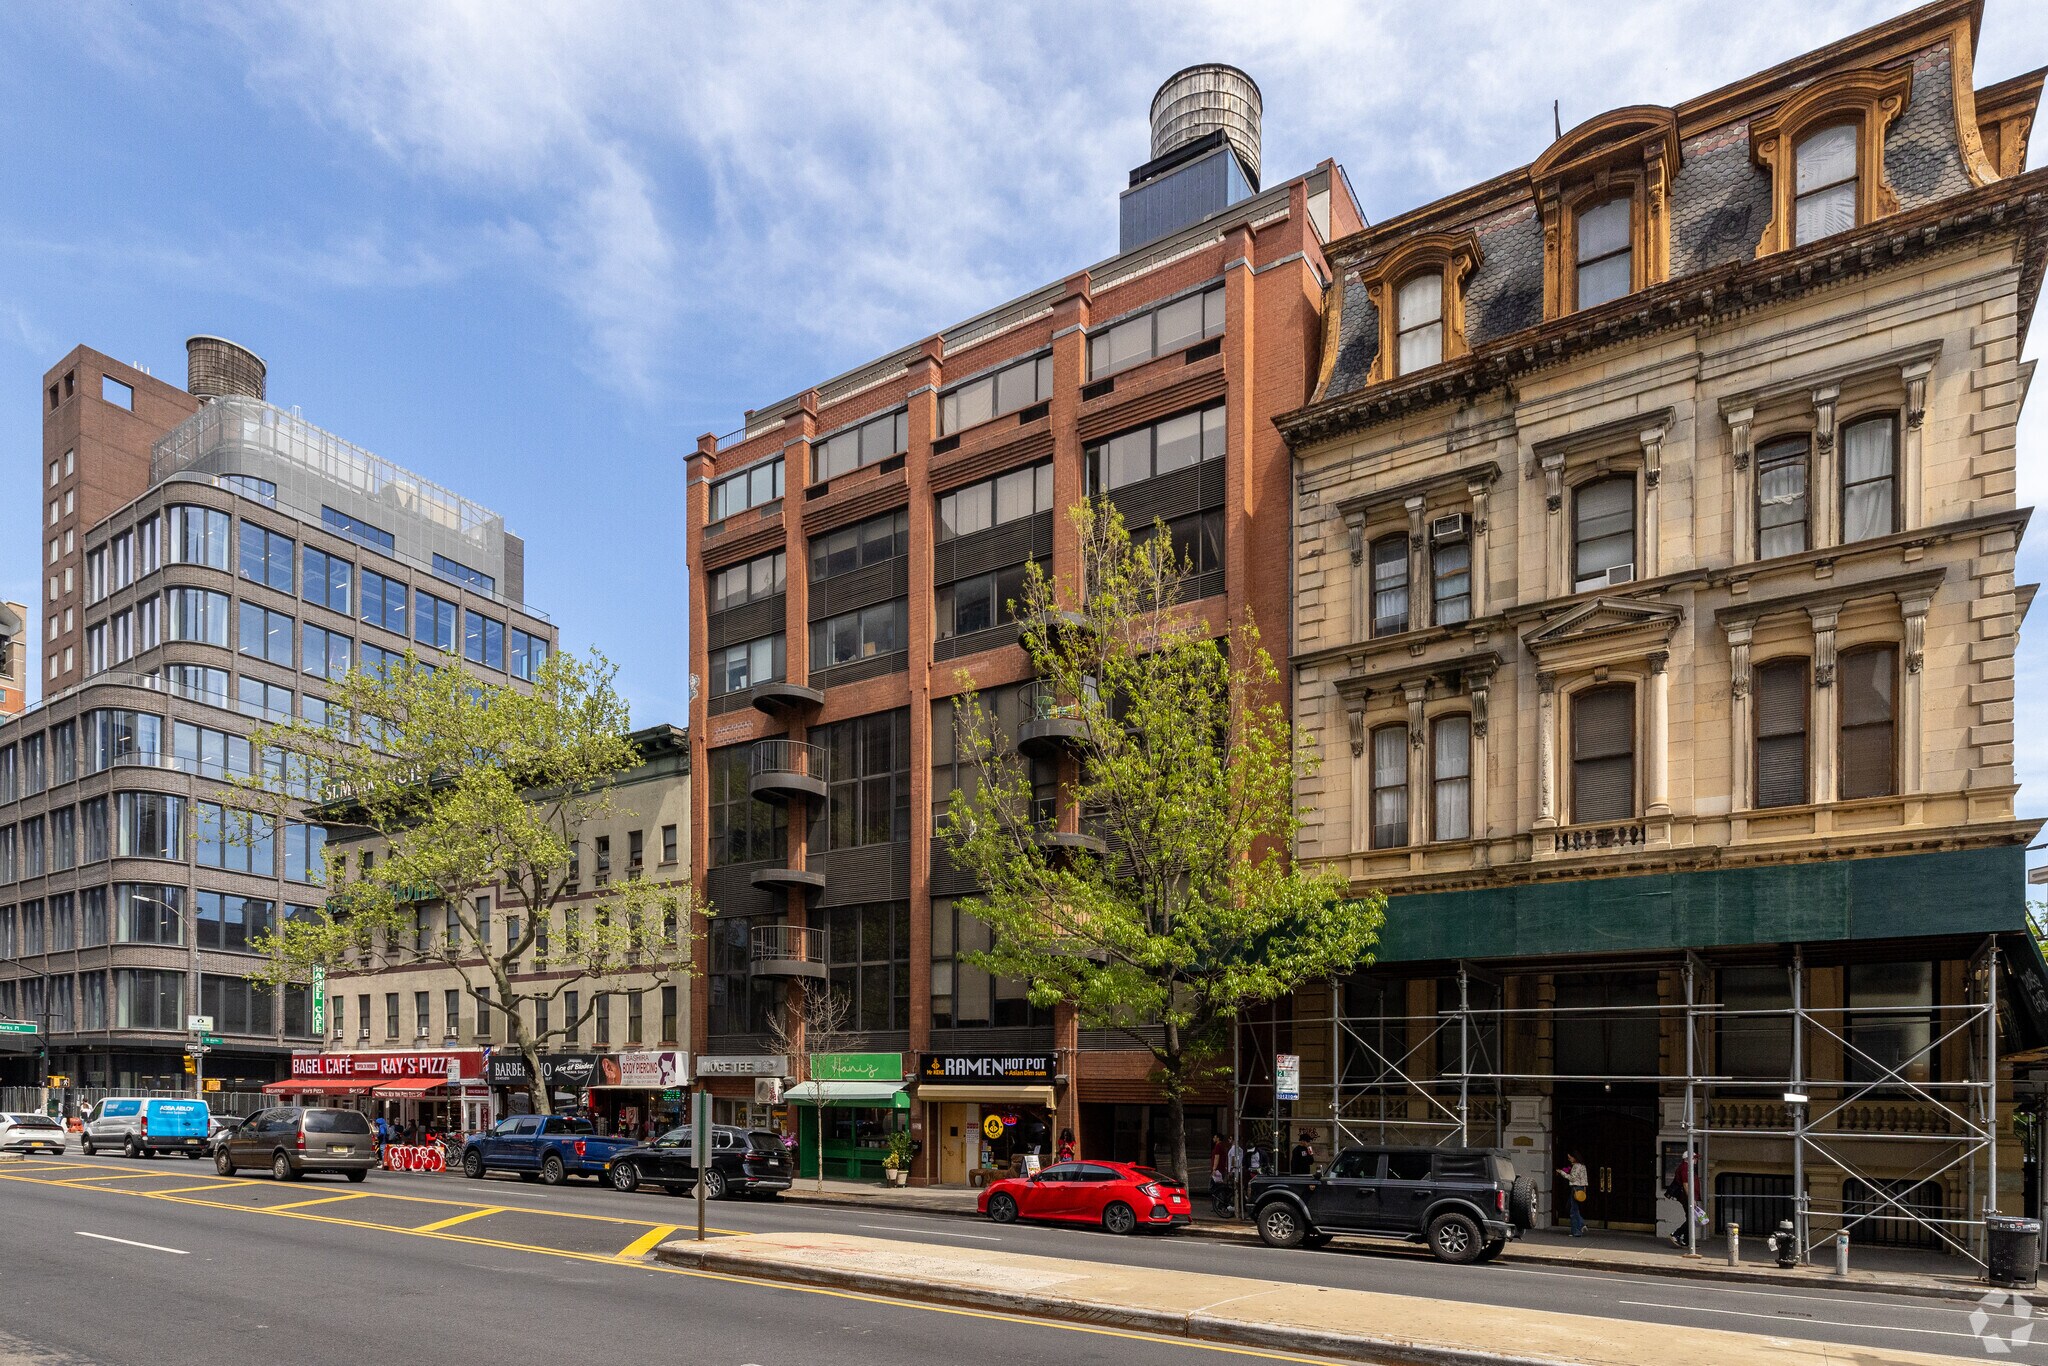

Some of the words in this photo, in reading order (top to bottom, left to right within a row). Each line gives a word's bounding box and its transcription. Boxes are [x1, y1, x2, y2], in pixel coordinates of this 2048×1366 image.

[315, 1005, 323, 1034] CAFE
[293, 1059, 323, 1074] BAGEL
[325, 1055, 352, 1074] CAFÉ
[626, 1054, 649, 1062] BASHIRA
[1004, 1058, 1024, 1070] HOT
[1026, 1058, 1046, 1070] POT
[381, 1058, 416, 1074] RAY'S
[420, 1057, 449, 1073] PIZZ
[623, 1062, 635, 1074] BODY
[636, 1062, 658, 1074] PIERCING
[702, 1061, 732, 1073] MOGE
[733, 1061, 753, 1073] TEE
[945, 1058, 1004, 1076] RAMEN
